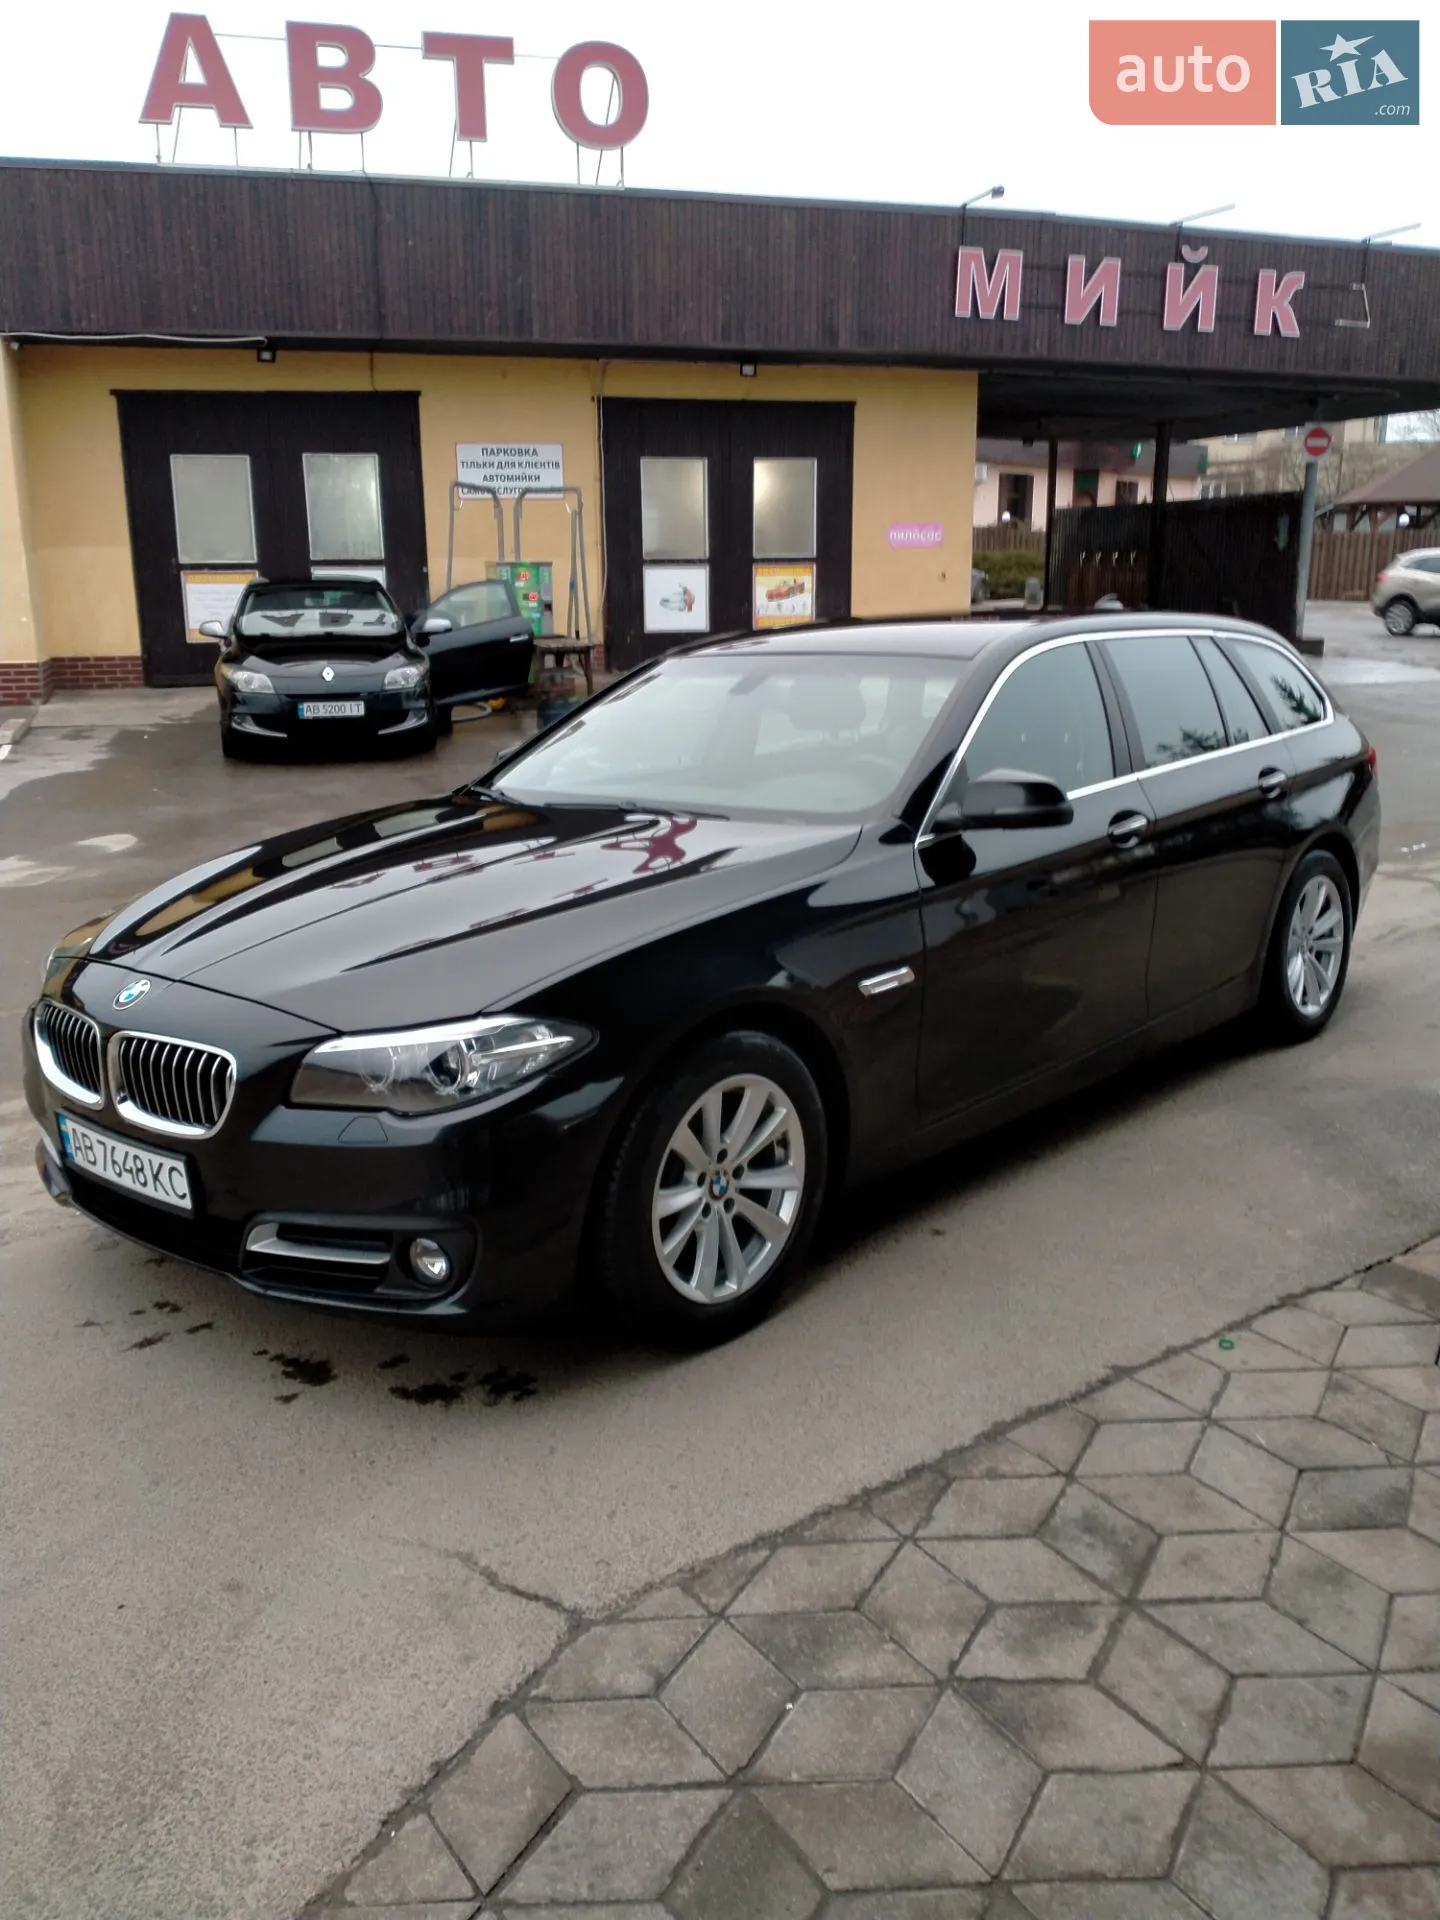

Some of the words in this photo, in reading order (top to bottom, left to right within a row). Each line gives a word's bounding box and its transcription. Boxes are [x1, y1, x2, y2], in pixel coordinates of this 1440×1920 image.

[138, 12, 649, 150] АВТО
[955, 244, 1305, 338] МИЙК
[481, 447, 539, 457] ПАРКОВКА
[460, 461, 495, 470] ТІЛЬКИ
[496, 461, 517, 470] ДЛЯ
[518, 461, 561, 470] КЛІЄНТІВ
[482, 473, 541, 482] АВТОМИЙКИ
